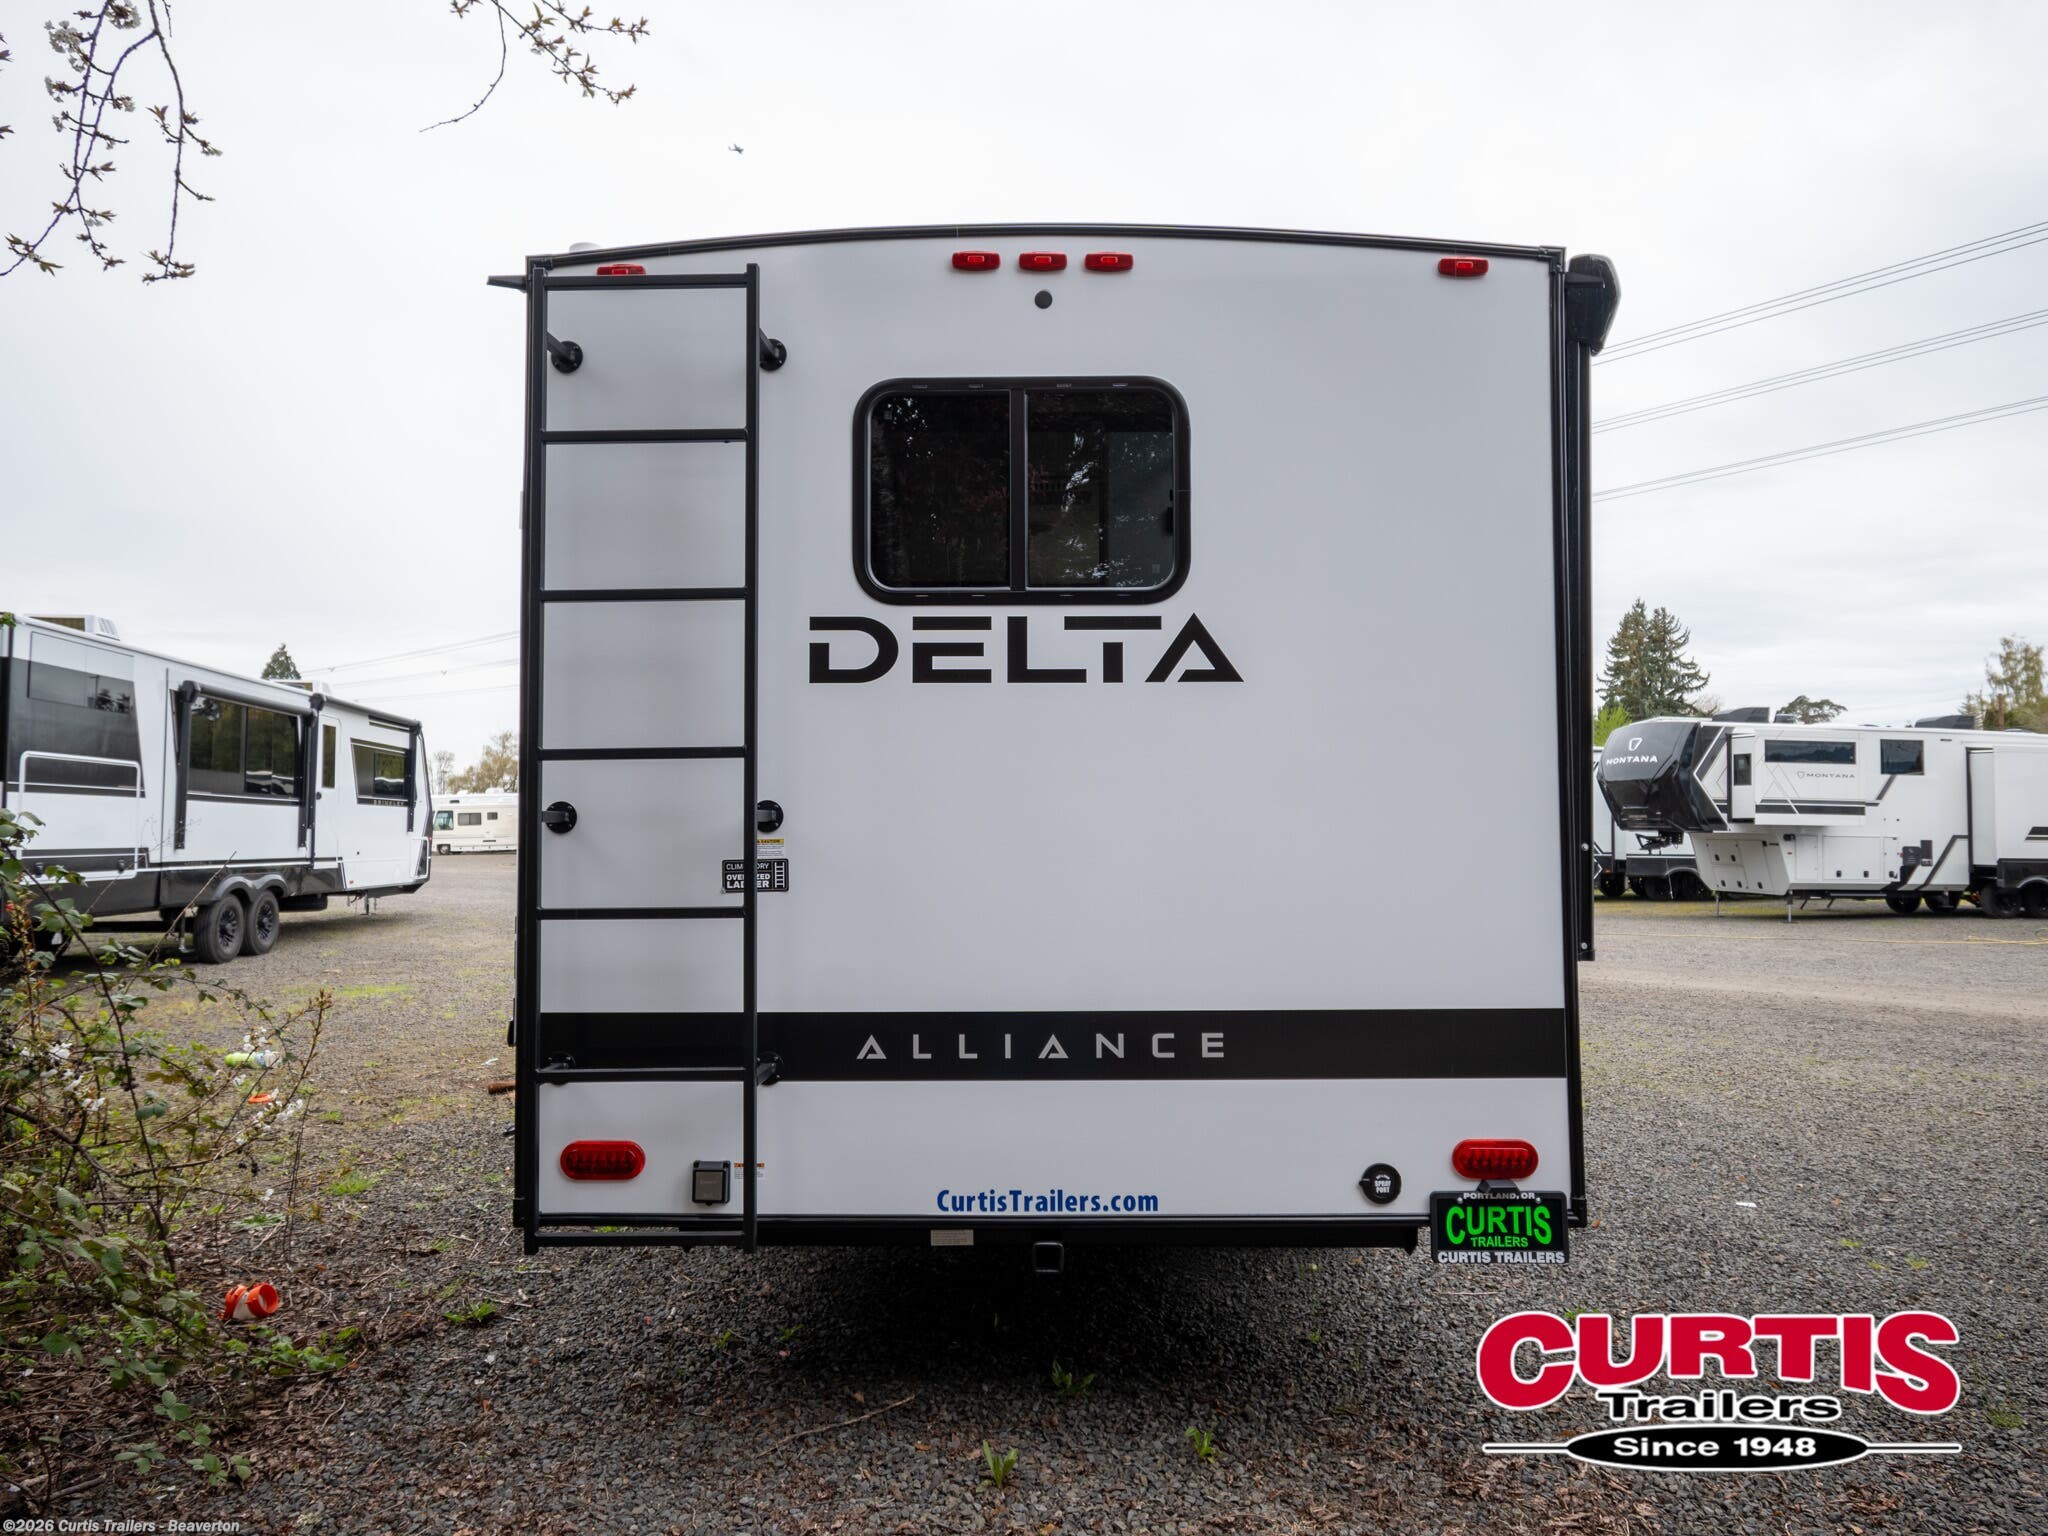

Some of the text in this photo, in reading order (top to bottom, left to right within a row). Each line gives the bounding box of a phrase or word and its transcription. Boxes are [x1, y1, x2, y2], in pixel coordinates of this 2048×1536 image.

[809, 612, 1244, 683] DELTA
[1606, 755, 1658, 765] MONTANA
[856, 1033, 1224, 1060] ALLIANCE
[937, 1189, 1158, 1212] CurtisTrailers.com
[1463, 1192, 1535, 1200] PORTLAND, OR
[1446, 1206, 1552, 1245] CURTIS
[1470, 1236, 1528, 1247] TRAILERS
[1438, 1251, 1565, 1264] CURTIS TRAILERS
